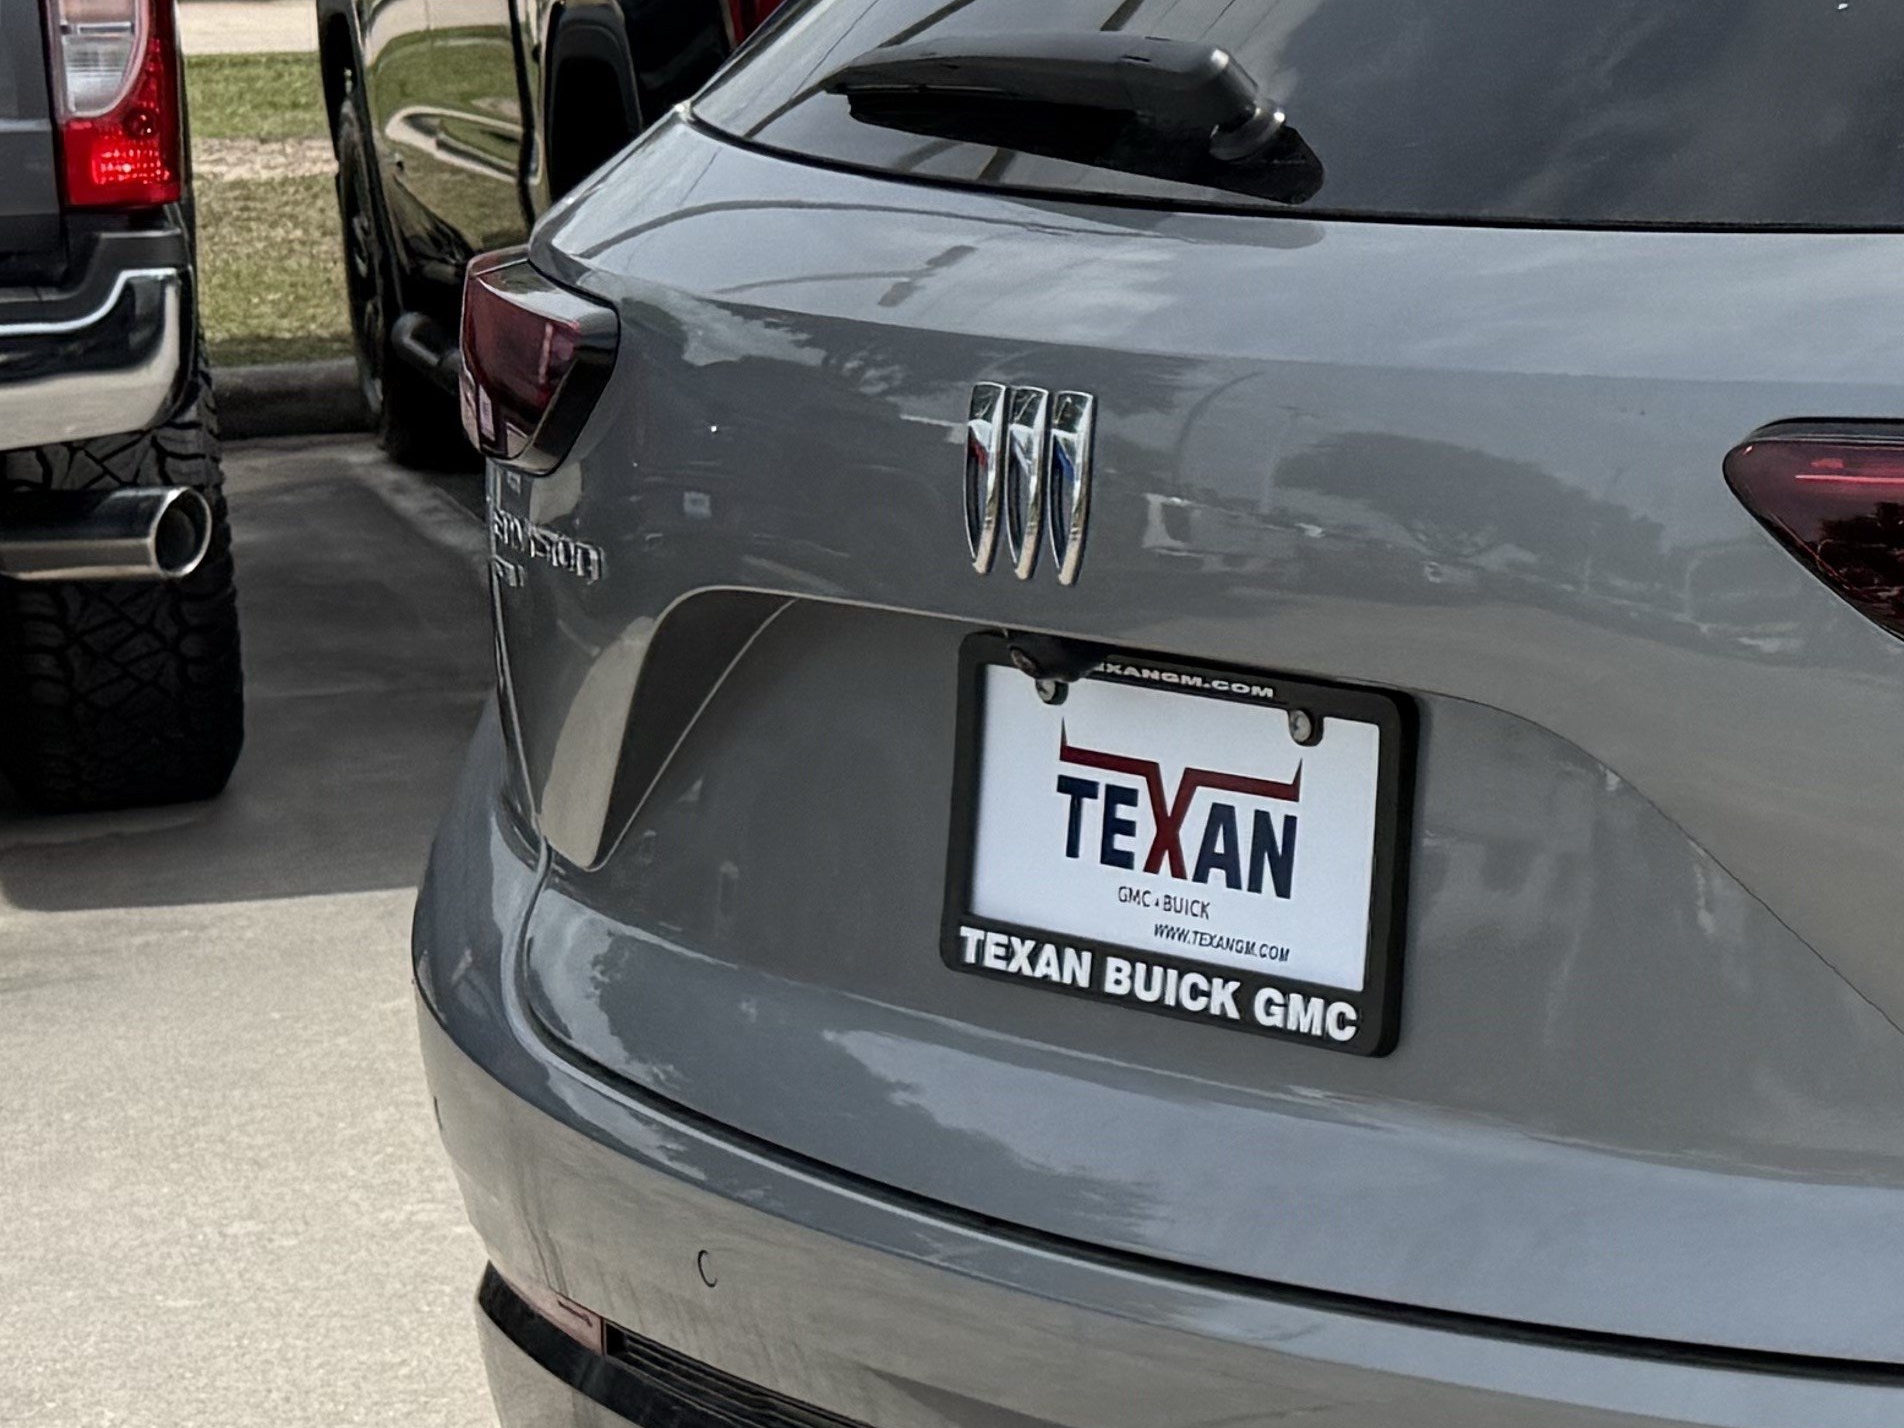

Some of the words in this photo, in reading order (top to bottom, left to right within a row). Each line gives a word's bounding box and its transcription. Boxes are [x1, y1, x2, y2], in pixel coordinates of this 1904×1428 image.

[1057, 717, 1303, 900] TEXAN
[1162, 893, 1211, 920] BUICK
[960, 925, 1092, 988] TEXAN
[1104, 956, 1241, 1020] BUICK
[1254, 987, 1357, 1043] GMC
